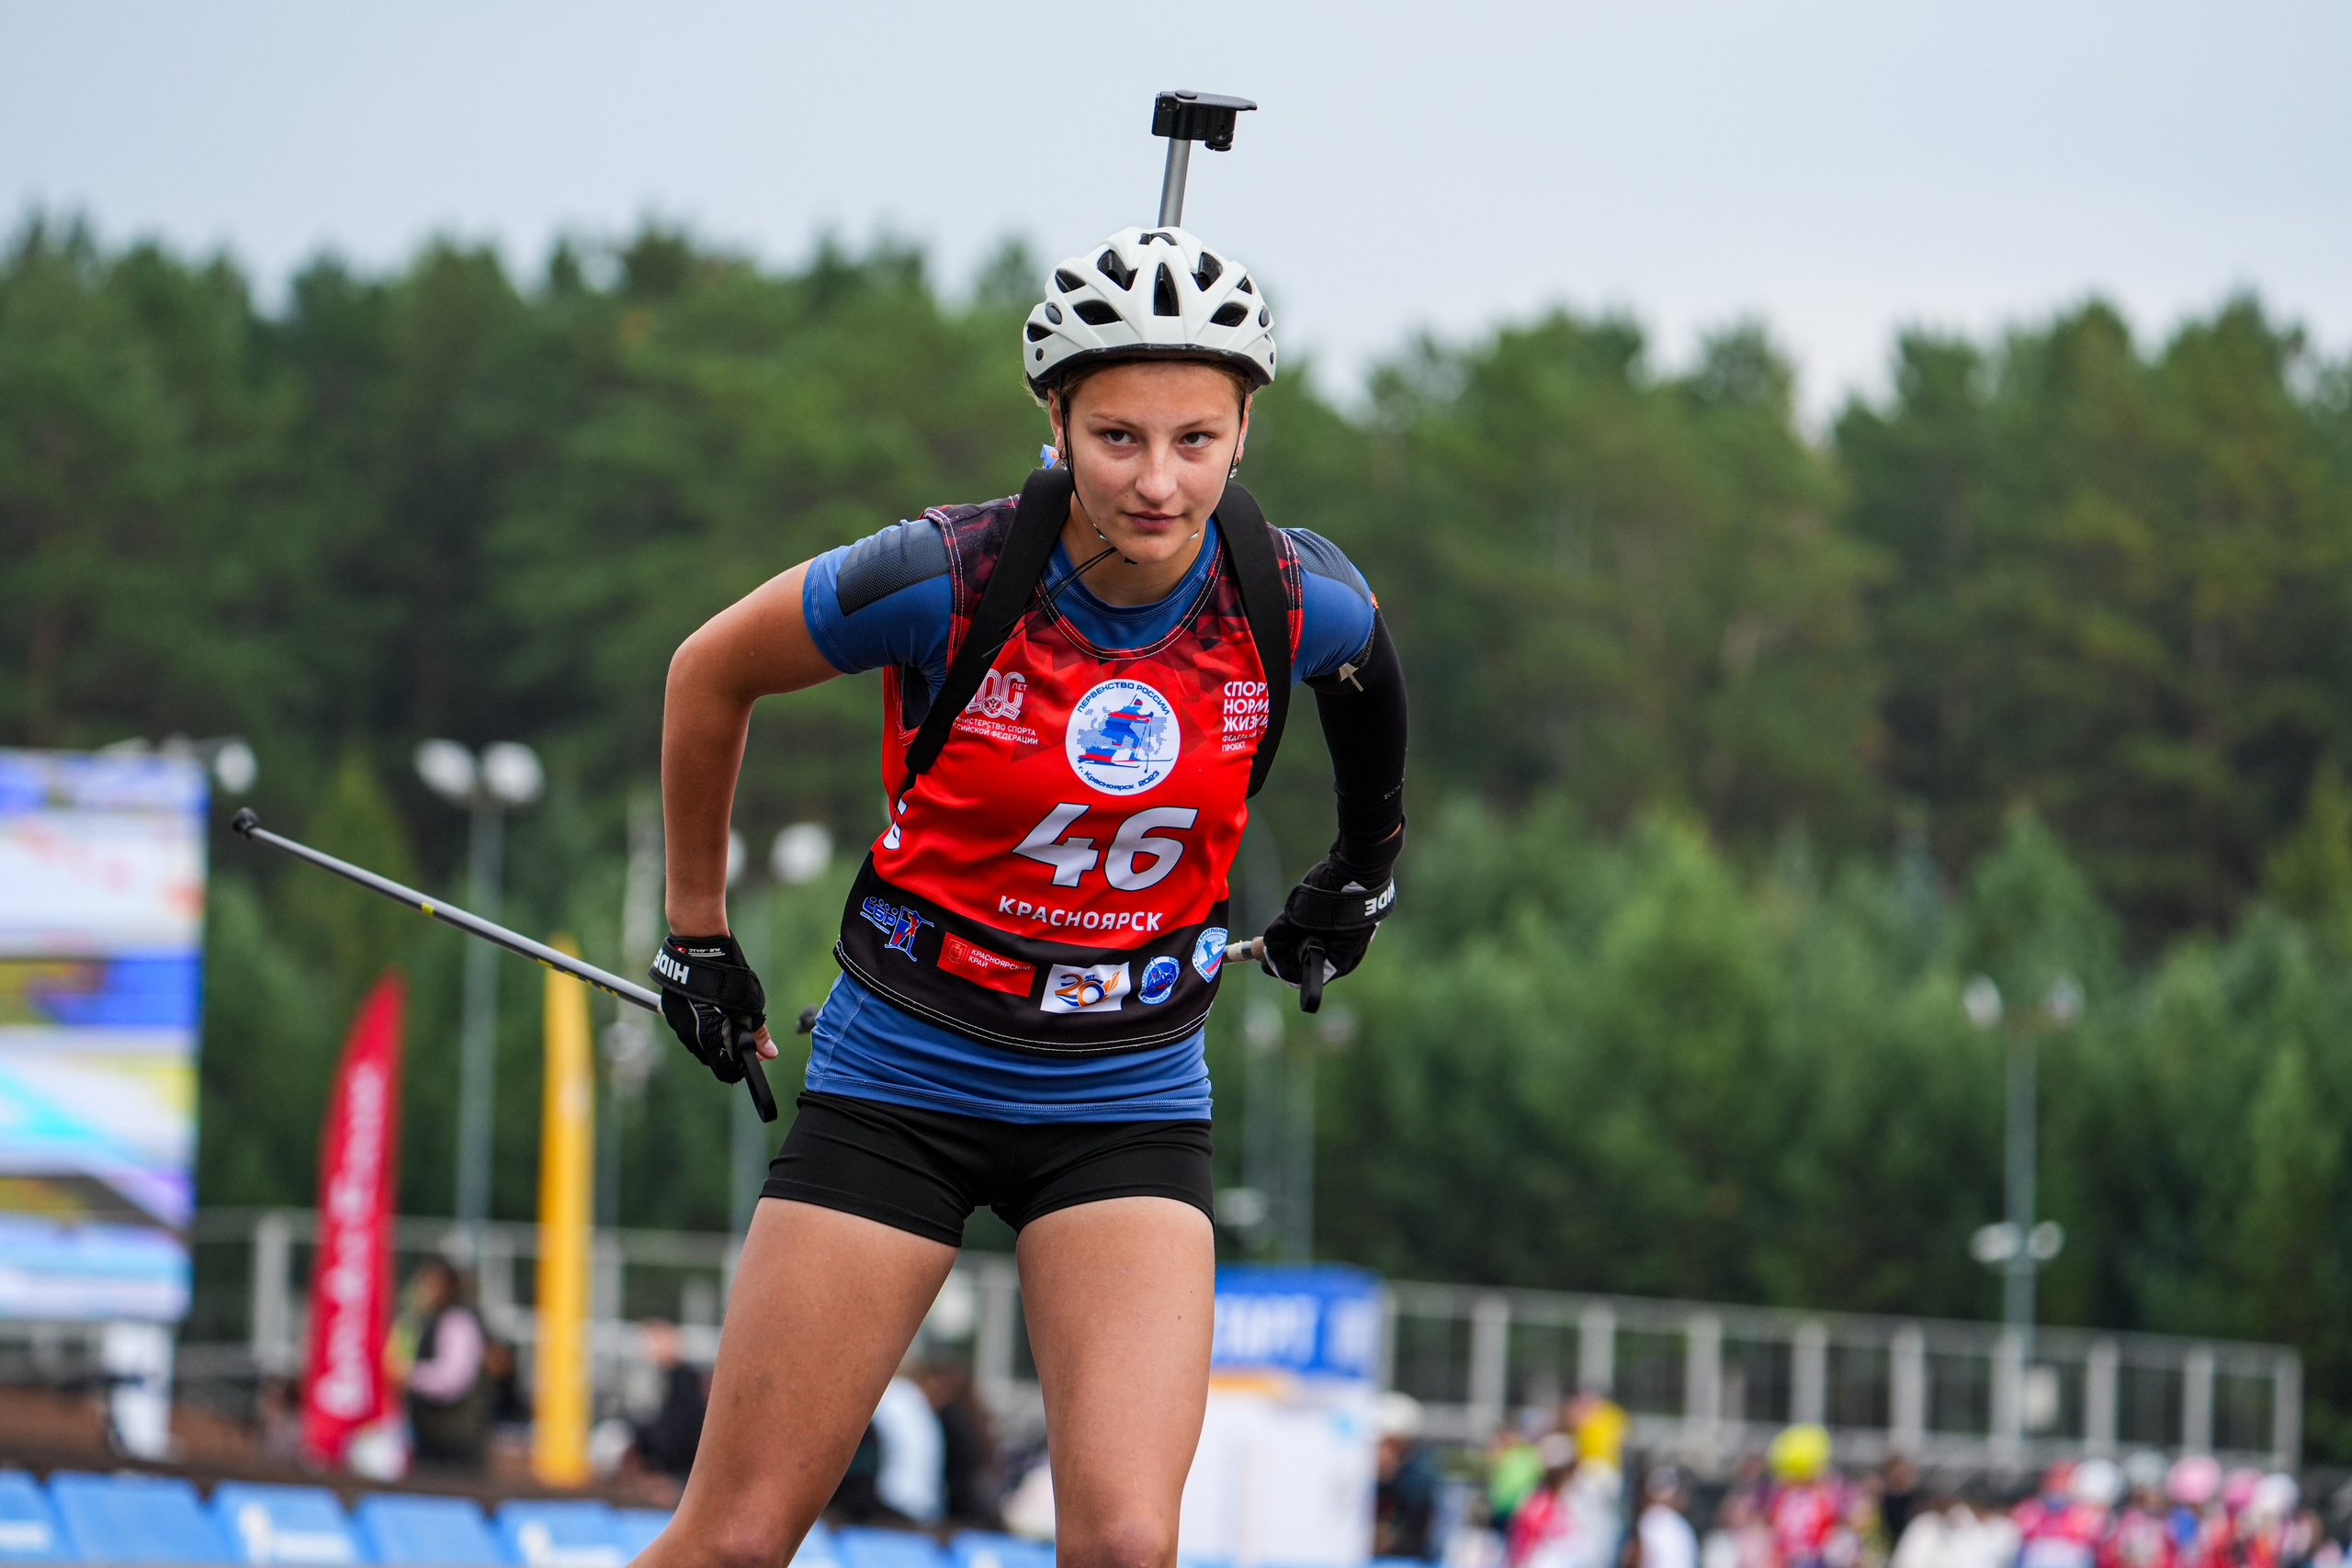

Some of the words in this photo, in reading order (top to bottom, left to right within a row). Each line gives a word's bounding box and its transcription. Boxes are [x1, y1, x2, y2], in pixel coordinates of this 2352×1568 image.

[970, 669, 1025, 709] 00
[1012, 682, 1028, 692] ЛЕТ
[1077, 682, 1135, 713] ПЕРВЕНСТВО
[1136, 684, 1170, 716] РОССИИ
[1223, 698, 1270, 715] НОРМ
[953, 722, 989, 735] ССИЙСКОЙ
[991, 731, 1039, 745] ФЕДЕРАЦИИ
[955, 716, 1006, 730] ИНИСТЕРСТВО
[1007, 725, 1036, 736] СПОРТА
[1222, 741, 1246, 752] ПРОЕКТ
[1084, 771, 1135, 791] Красноярск
[1137, 770, 1160, 787] 2023
[1012, 802, 1199, 892] 46
[998, 895, 1164, 932] КРАСНОЯРСК
[967, 955, 989, 969] КРАЙ
